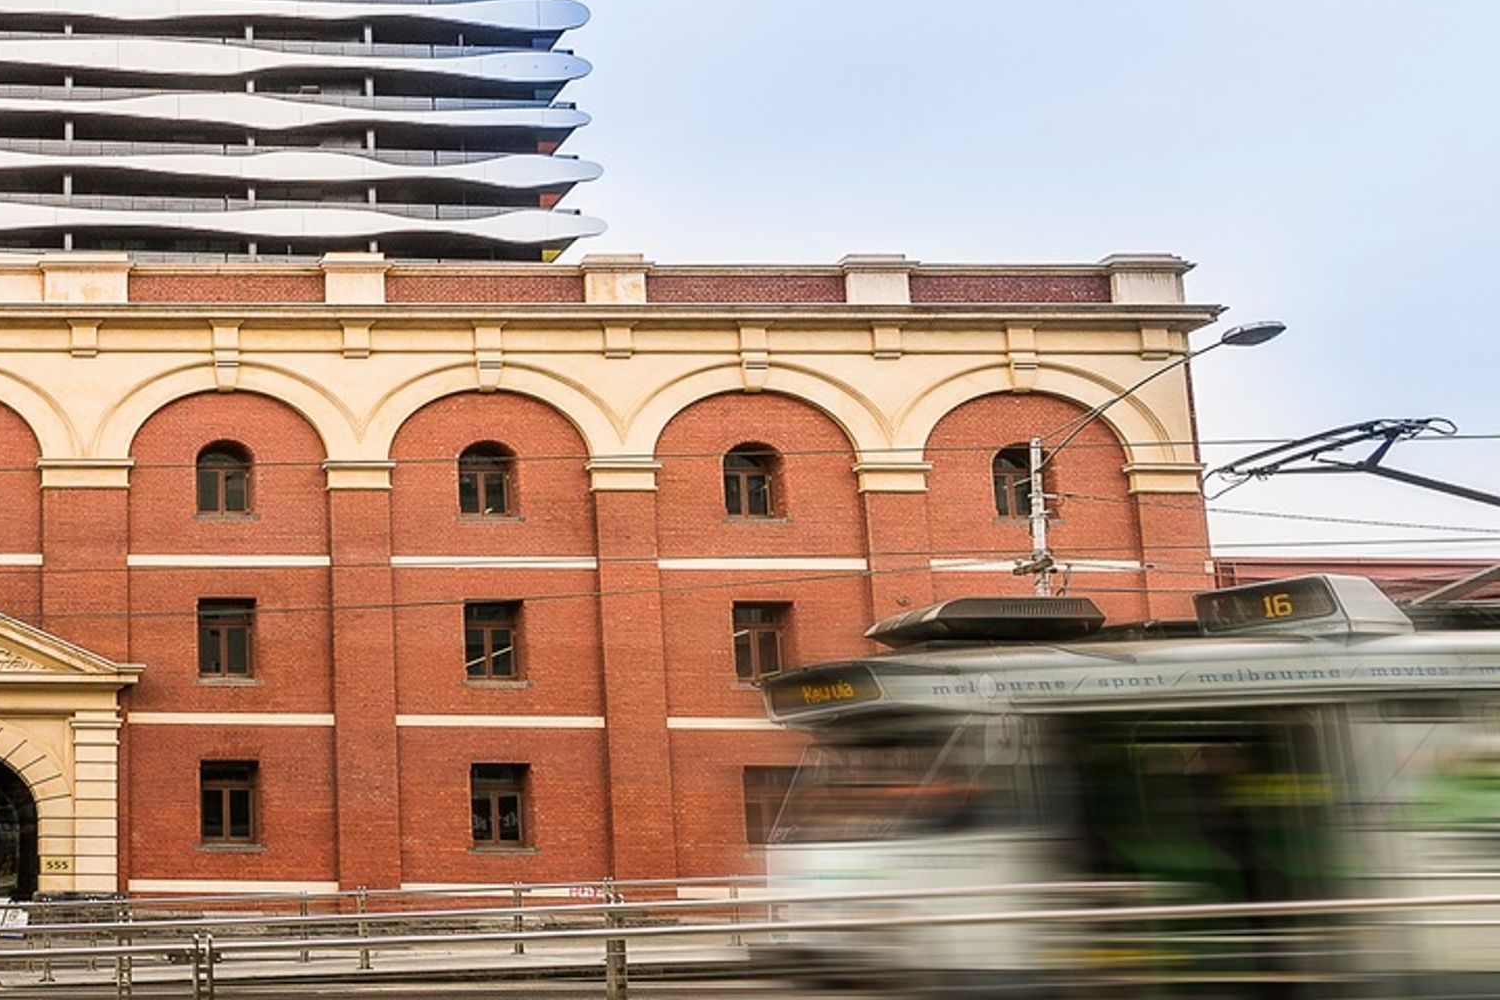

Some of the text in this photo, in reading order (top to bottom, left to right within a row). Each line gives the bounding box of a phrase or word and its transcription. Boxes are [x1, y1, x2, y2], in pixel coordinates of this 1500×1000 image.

[1262, 593, 1293, 618] 16
[932, 679, 1066, 697] melourne
[1098, 673, 1165, 692] sport
[1198, 666, 1342, 683] melbourne
[1370, 664, 1450, 678] movies
[802, 682, 854, 703] Kew via
[46, 860, 69, 870] 555
